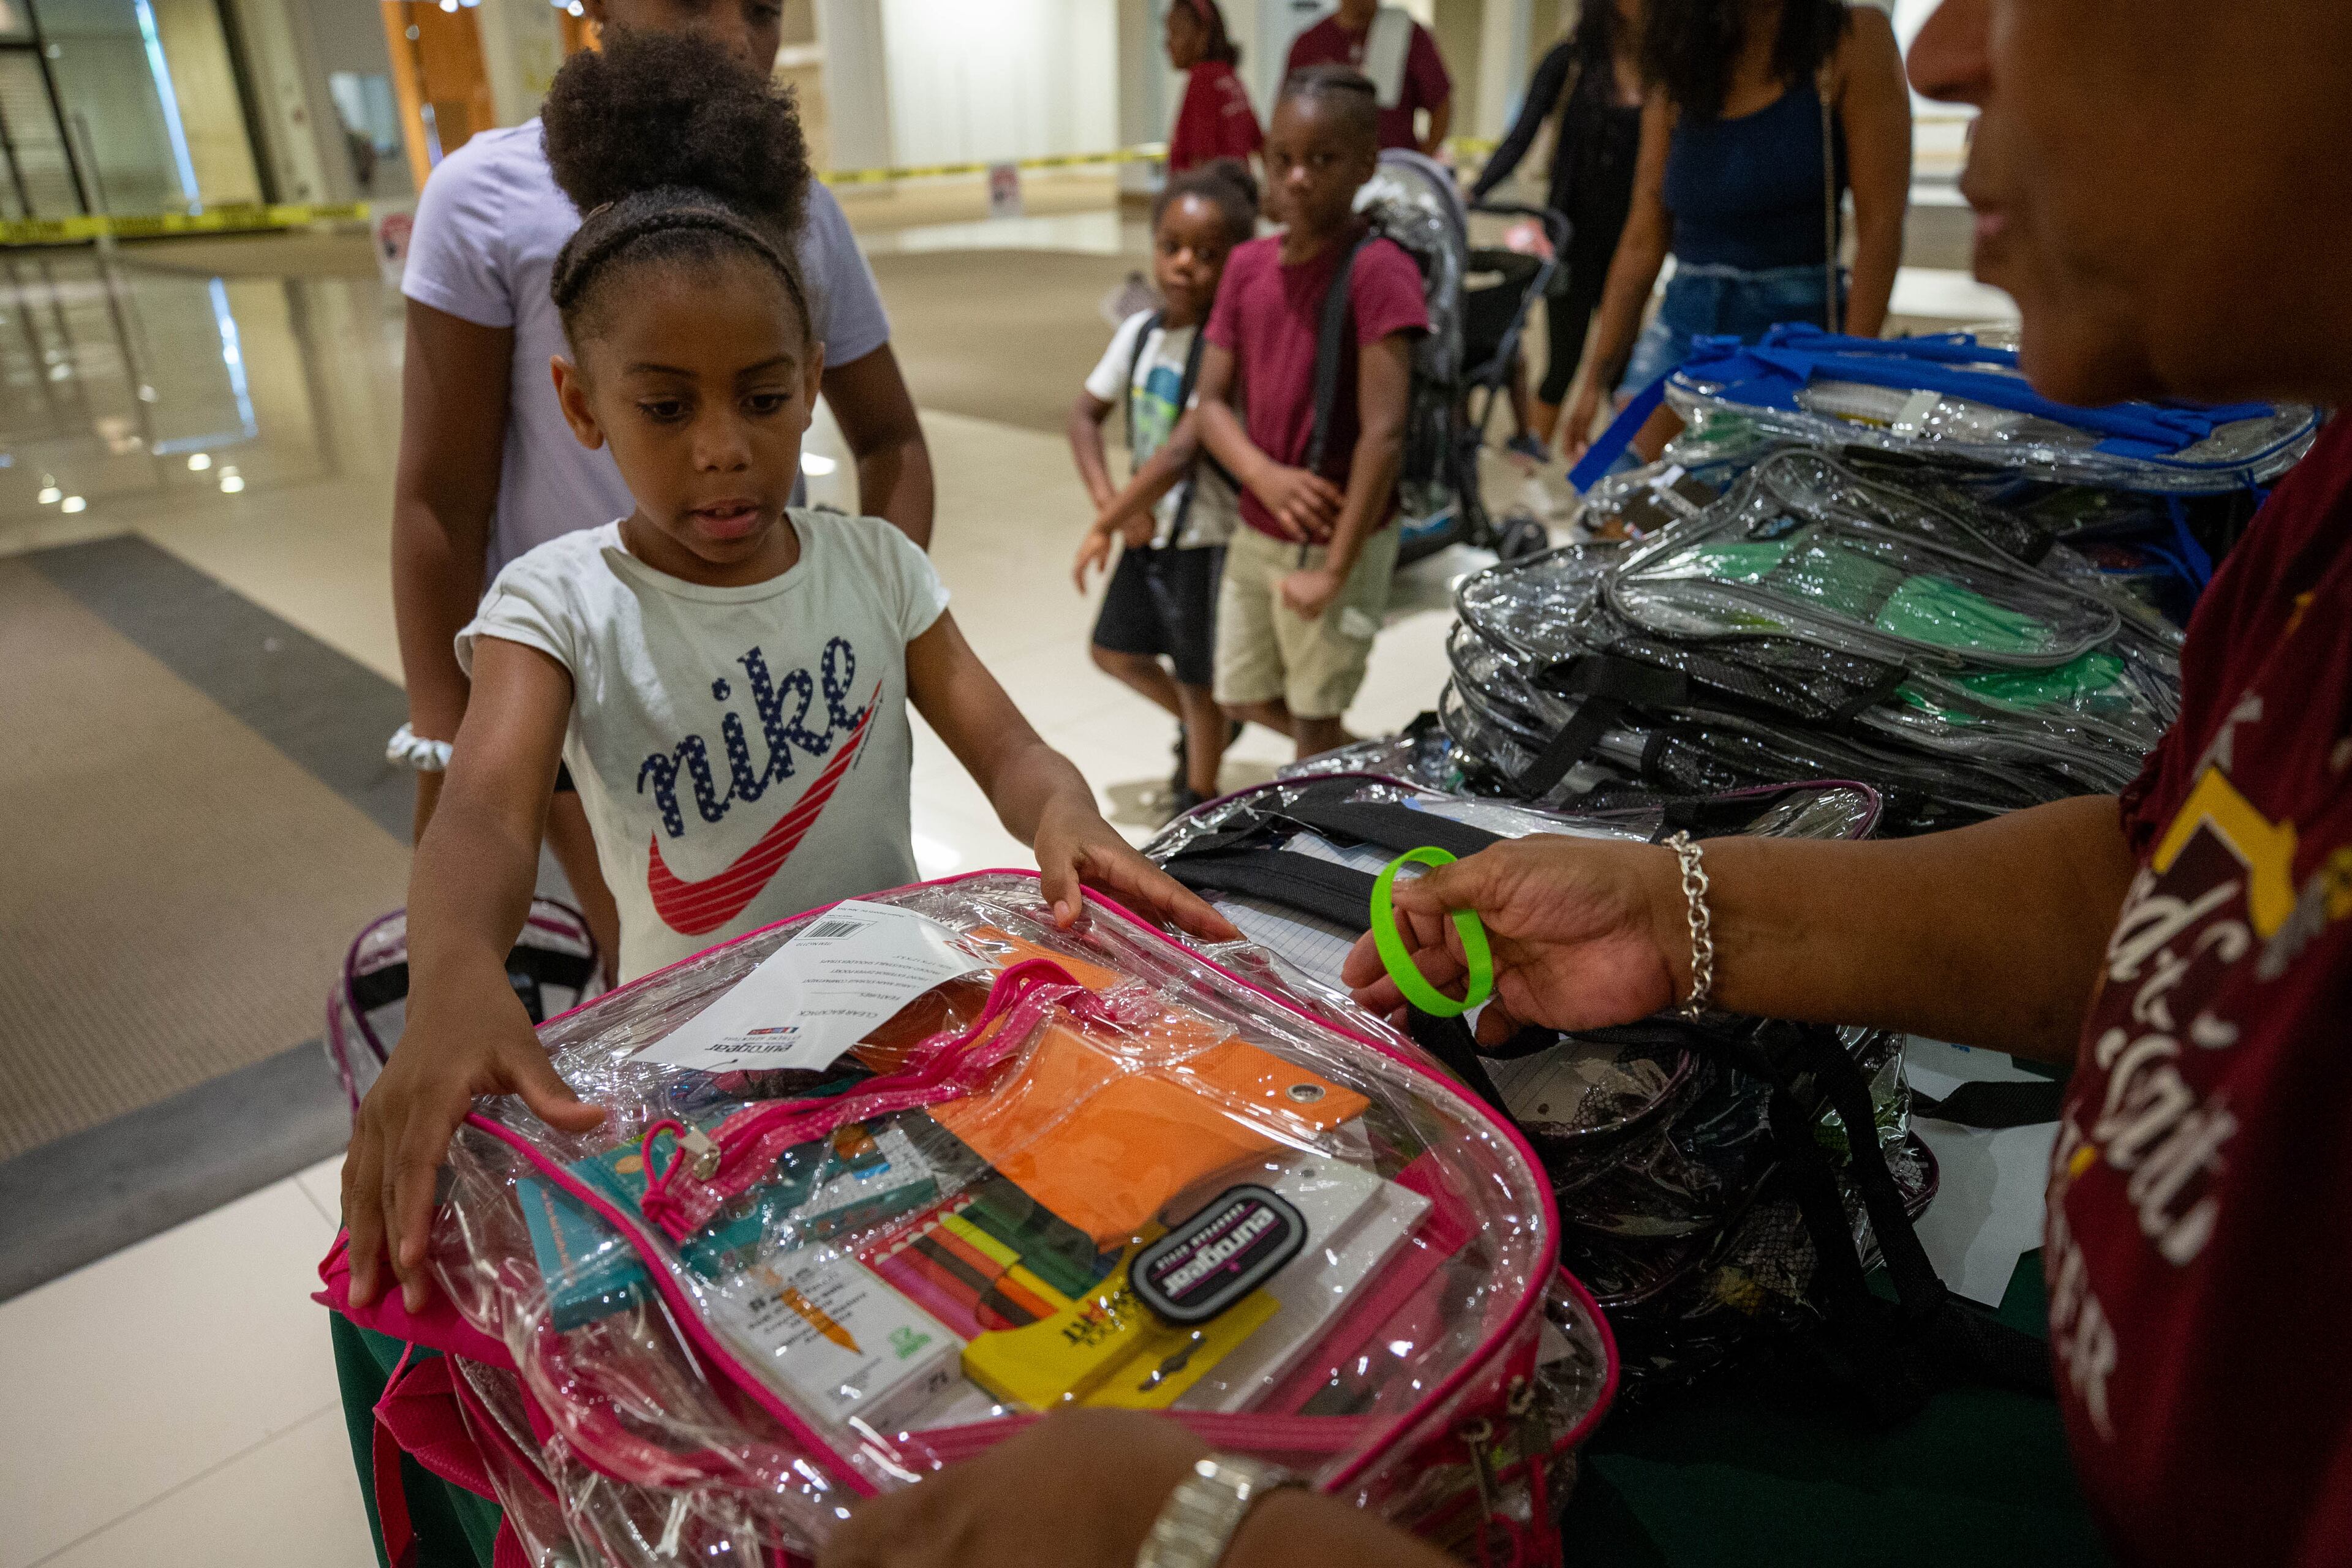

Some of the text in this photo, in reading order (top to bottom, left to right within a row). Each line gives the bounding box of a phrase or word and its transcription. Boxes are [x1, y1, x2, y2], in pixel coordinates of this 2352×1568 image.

[637, 636, 865, 838] nike
[705, 1043, 793, 1054] eurogear
[1163, 1205, 1276, 1299] eurogear
